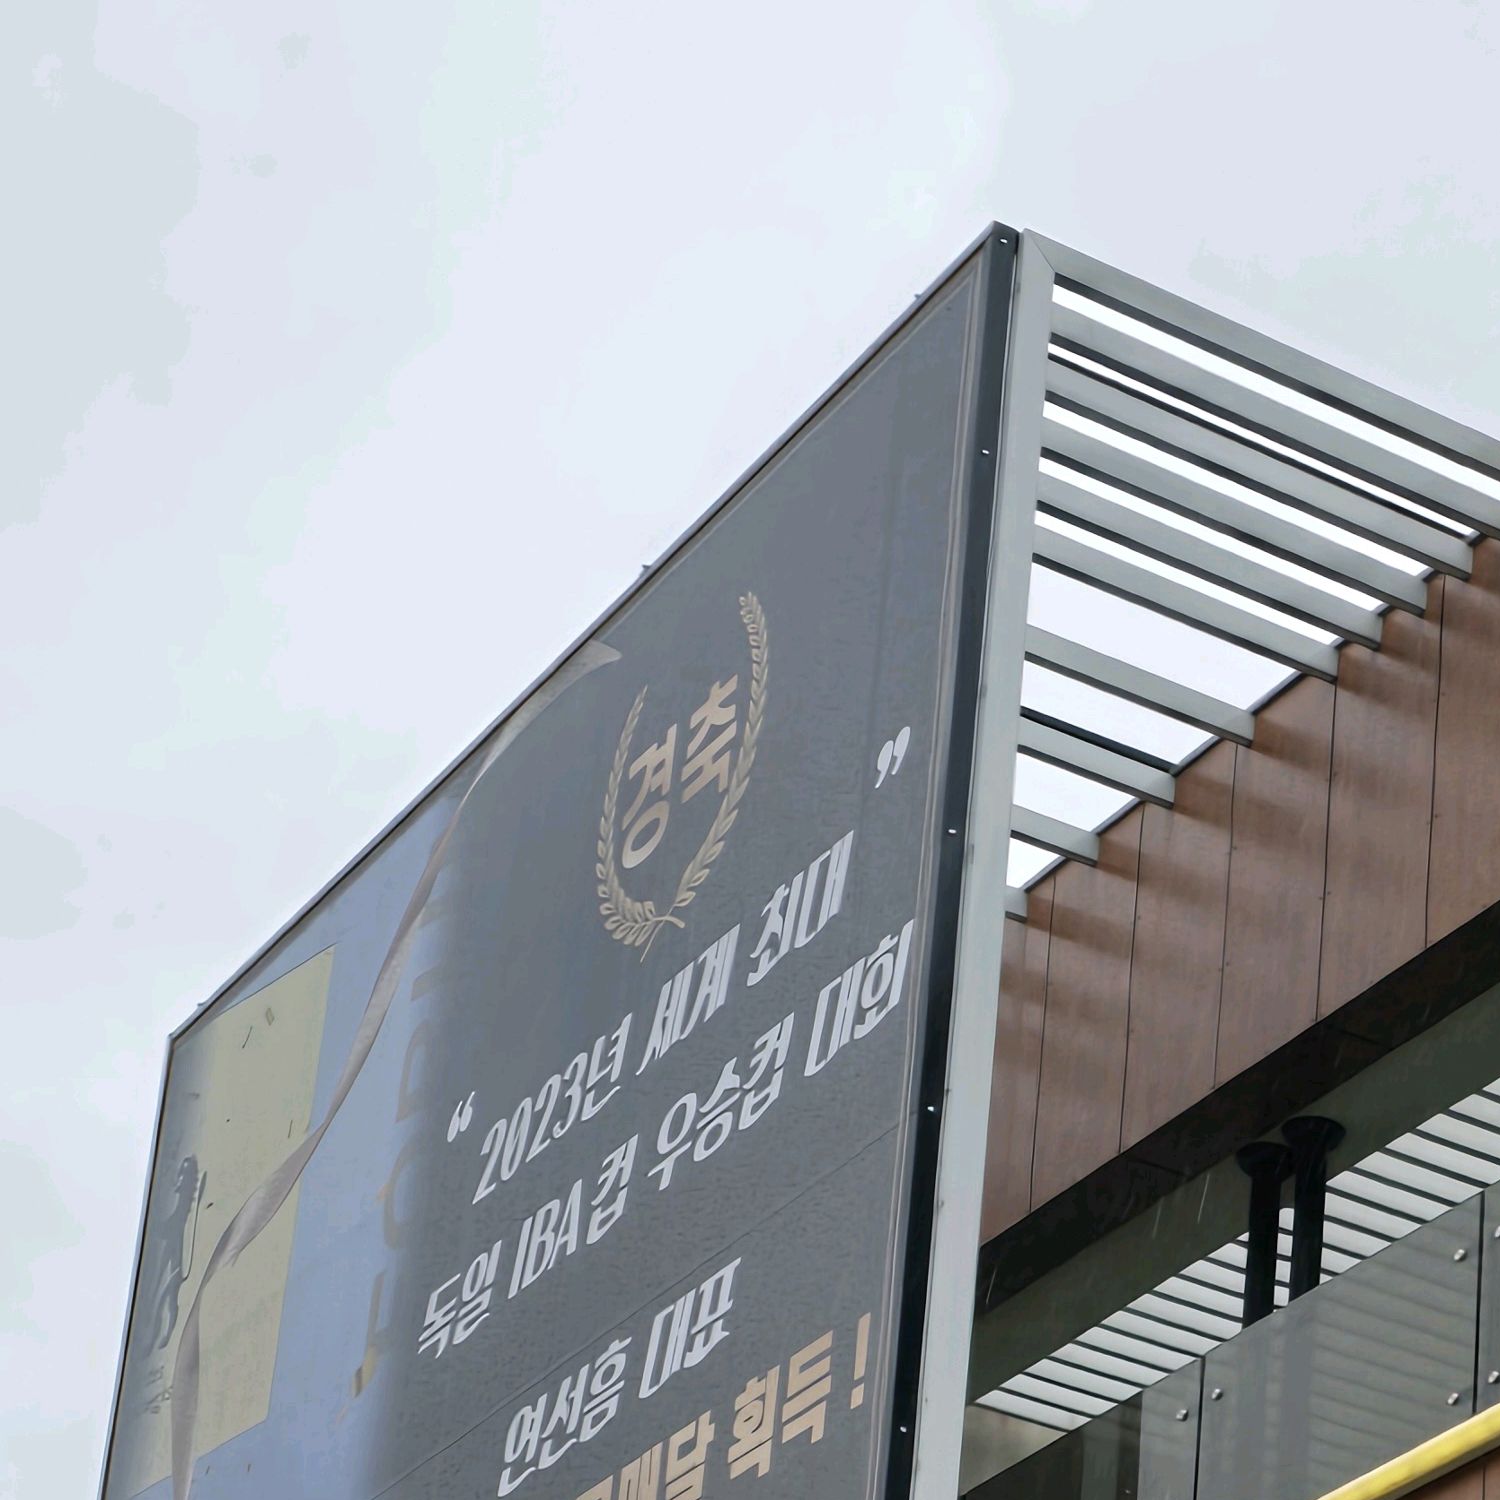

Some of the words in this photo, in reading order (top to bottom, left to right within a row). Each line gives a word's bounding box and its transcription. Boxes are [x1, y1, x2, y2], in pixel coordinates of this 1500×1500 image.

[622, 674, 738, 869] 경축
[417, 1240, 502, 1359] 독일
[508, 1180, 582, 1299] IBA
[587, 1134, 638, 1245] 컵
[648, 1012, 795, 1191] 우승컵
[803, 919, 916, 1077] 대회
[472, 1013, 633, 1204] 2023년
[636, 924, 741, 1076] 세계
[746, 830, 854, 986] 최대
[498, 1336, 632, 1497] 연선흠
[638, 1257, 742, 1400] 대표
